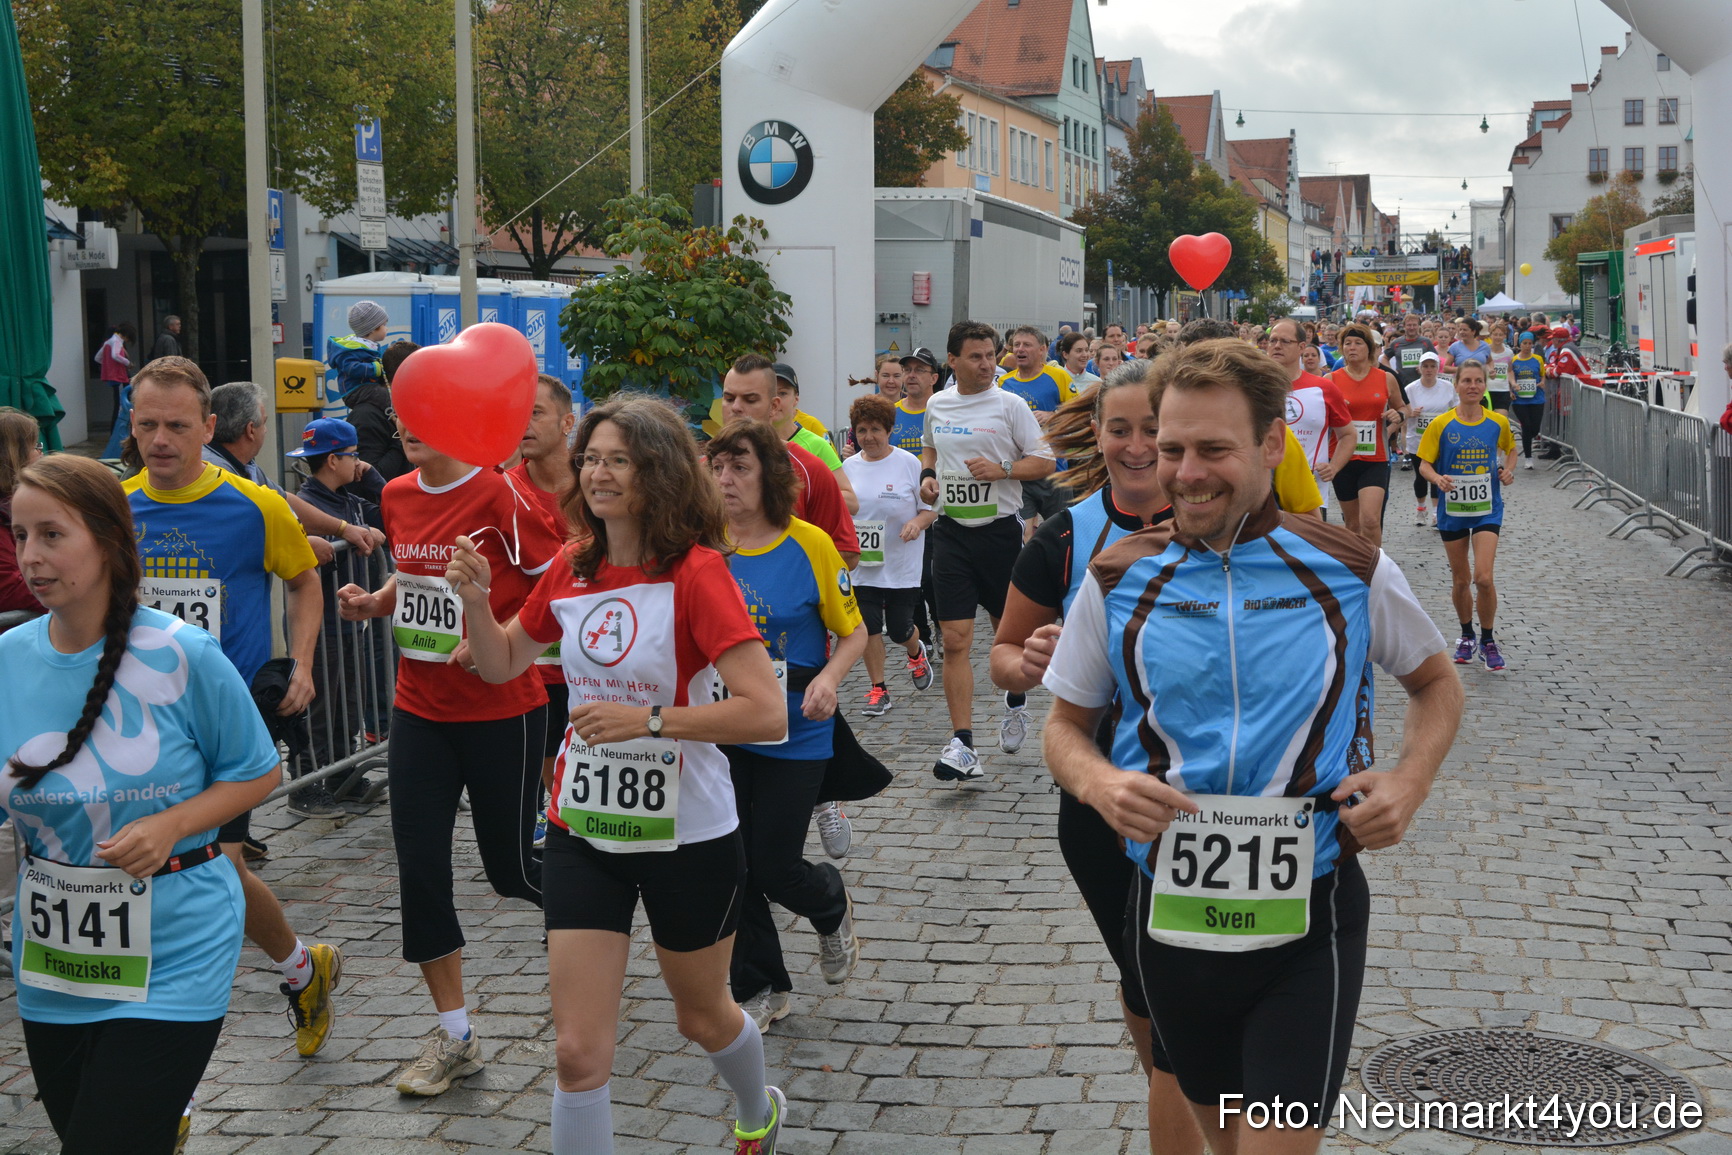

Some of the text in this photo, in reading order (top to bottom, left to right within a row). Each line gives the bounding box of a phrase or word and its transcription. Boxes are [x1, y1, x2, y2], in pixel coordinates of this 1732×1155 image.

[742, 121, 807, 150] BMW
[67, 252, 79, 260] Hut
[88, 251, 106, 260] Mode
[305, 273, 313, 292] 3
[1376, 274, 1408, 283] START
[946, 482, 992, 504] 5507
[1450, 485, 1488, 501] 5103
[151, 586, 202, 597] Neumarkt
[415, 582, 449, 594] Neumarkt
[401, 592, 457, 630] 5046
[411, 634, 437, 649] Anita
[626, 681, 659, 693] HERZ
[570, 743, 657, 762] PARTL Neumarkt
[13, 781, 182, 806] anders als andere
[571, 761, 666, 812] 5188
[586, 816, 642, 838] Claudia
[1173, 809, 1289, 827] ARTL Neumarkt
[1171, 832, 1299, 892] 5215
[25, 869, 124, 895] PARTL Neumarkt
[31, 891, 130, 949] 5141
[1205, 905, 1256, 929] Sven
[45, 952, 121, 981] Franziska
